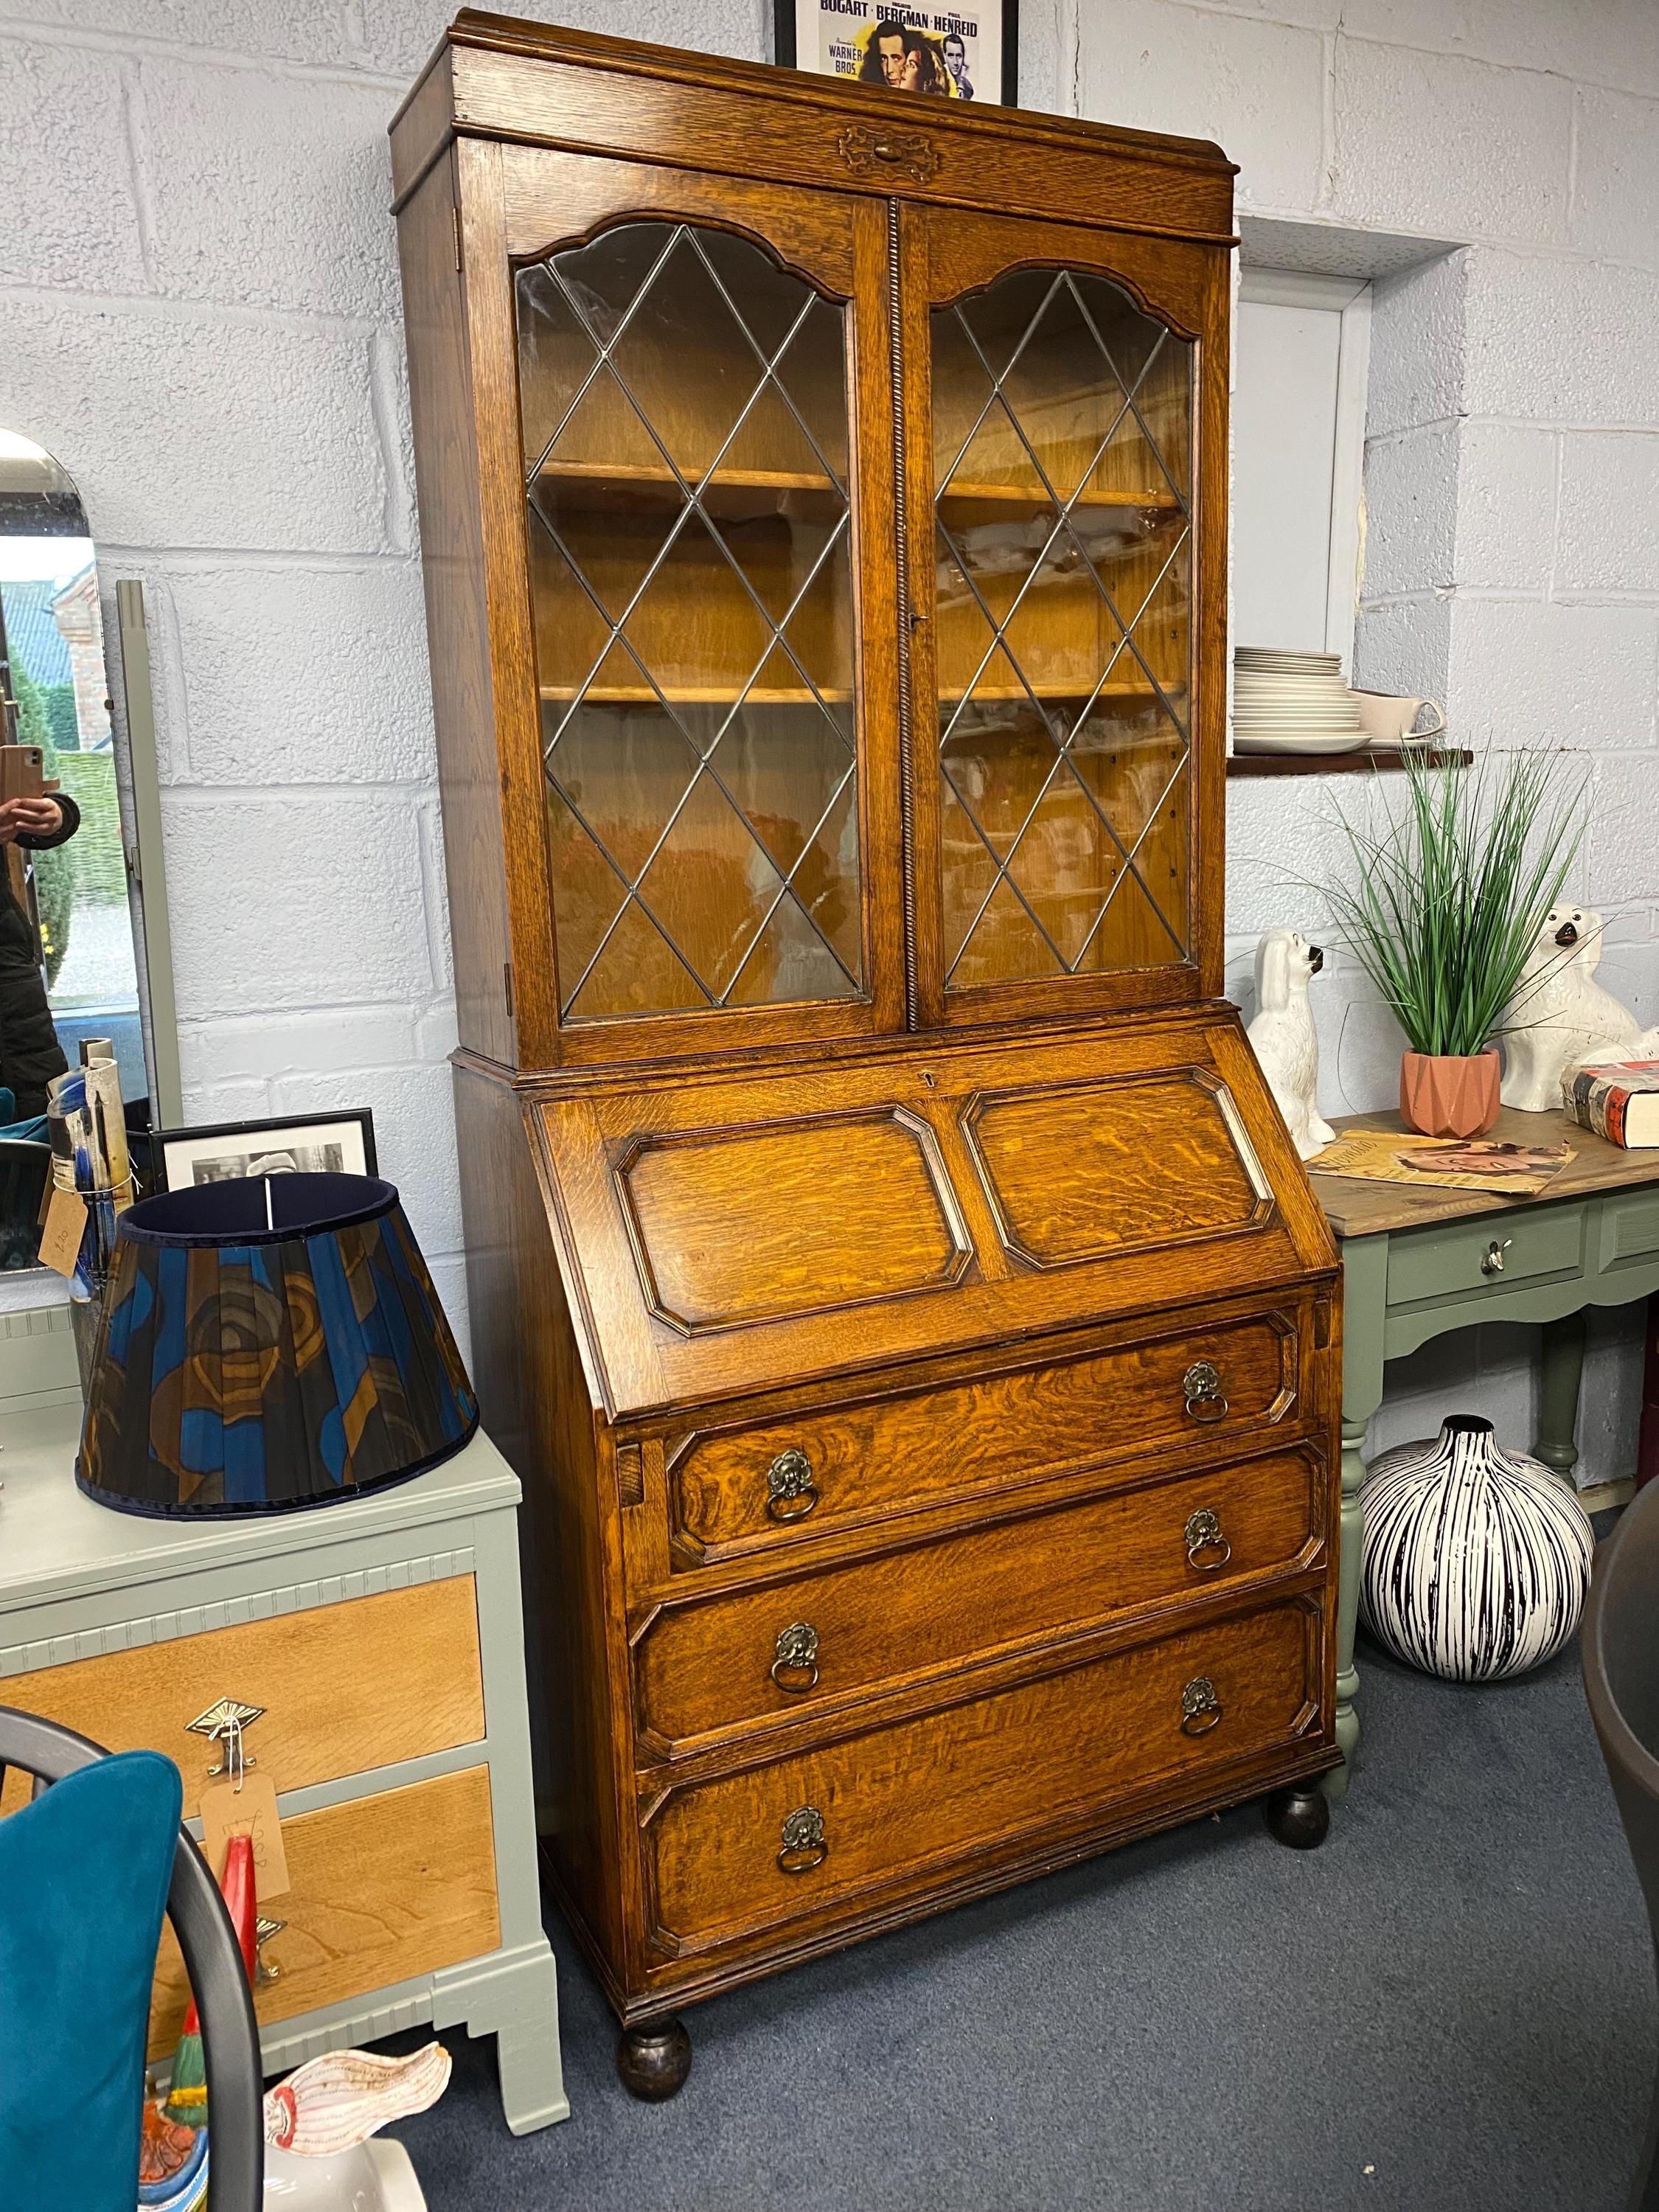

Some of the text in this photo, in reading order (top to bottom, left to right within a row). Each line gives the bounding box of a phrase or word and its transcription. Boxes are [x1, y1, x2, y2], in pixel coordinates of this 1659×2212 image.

[821, 0, 978, 38] BOGART BERGMAN HENREID
[829, 44, 862, 61] WARNER
